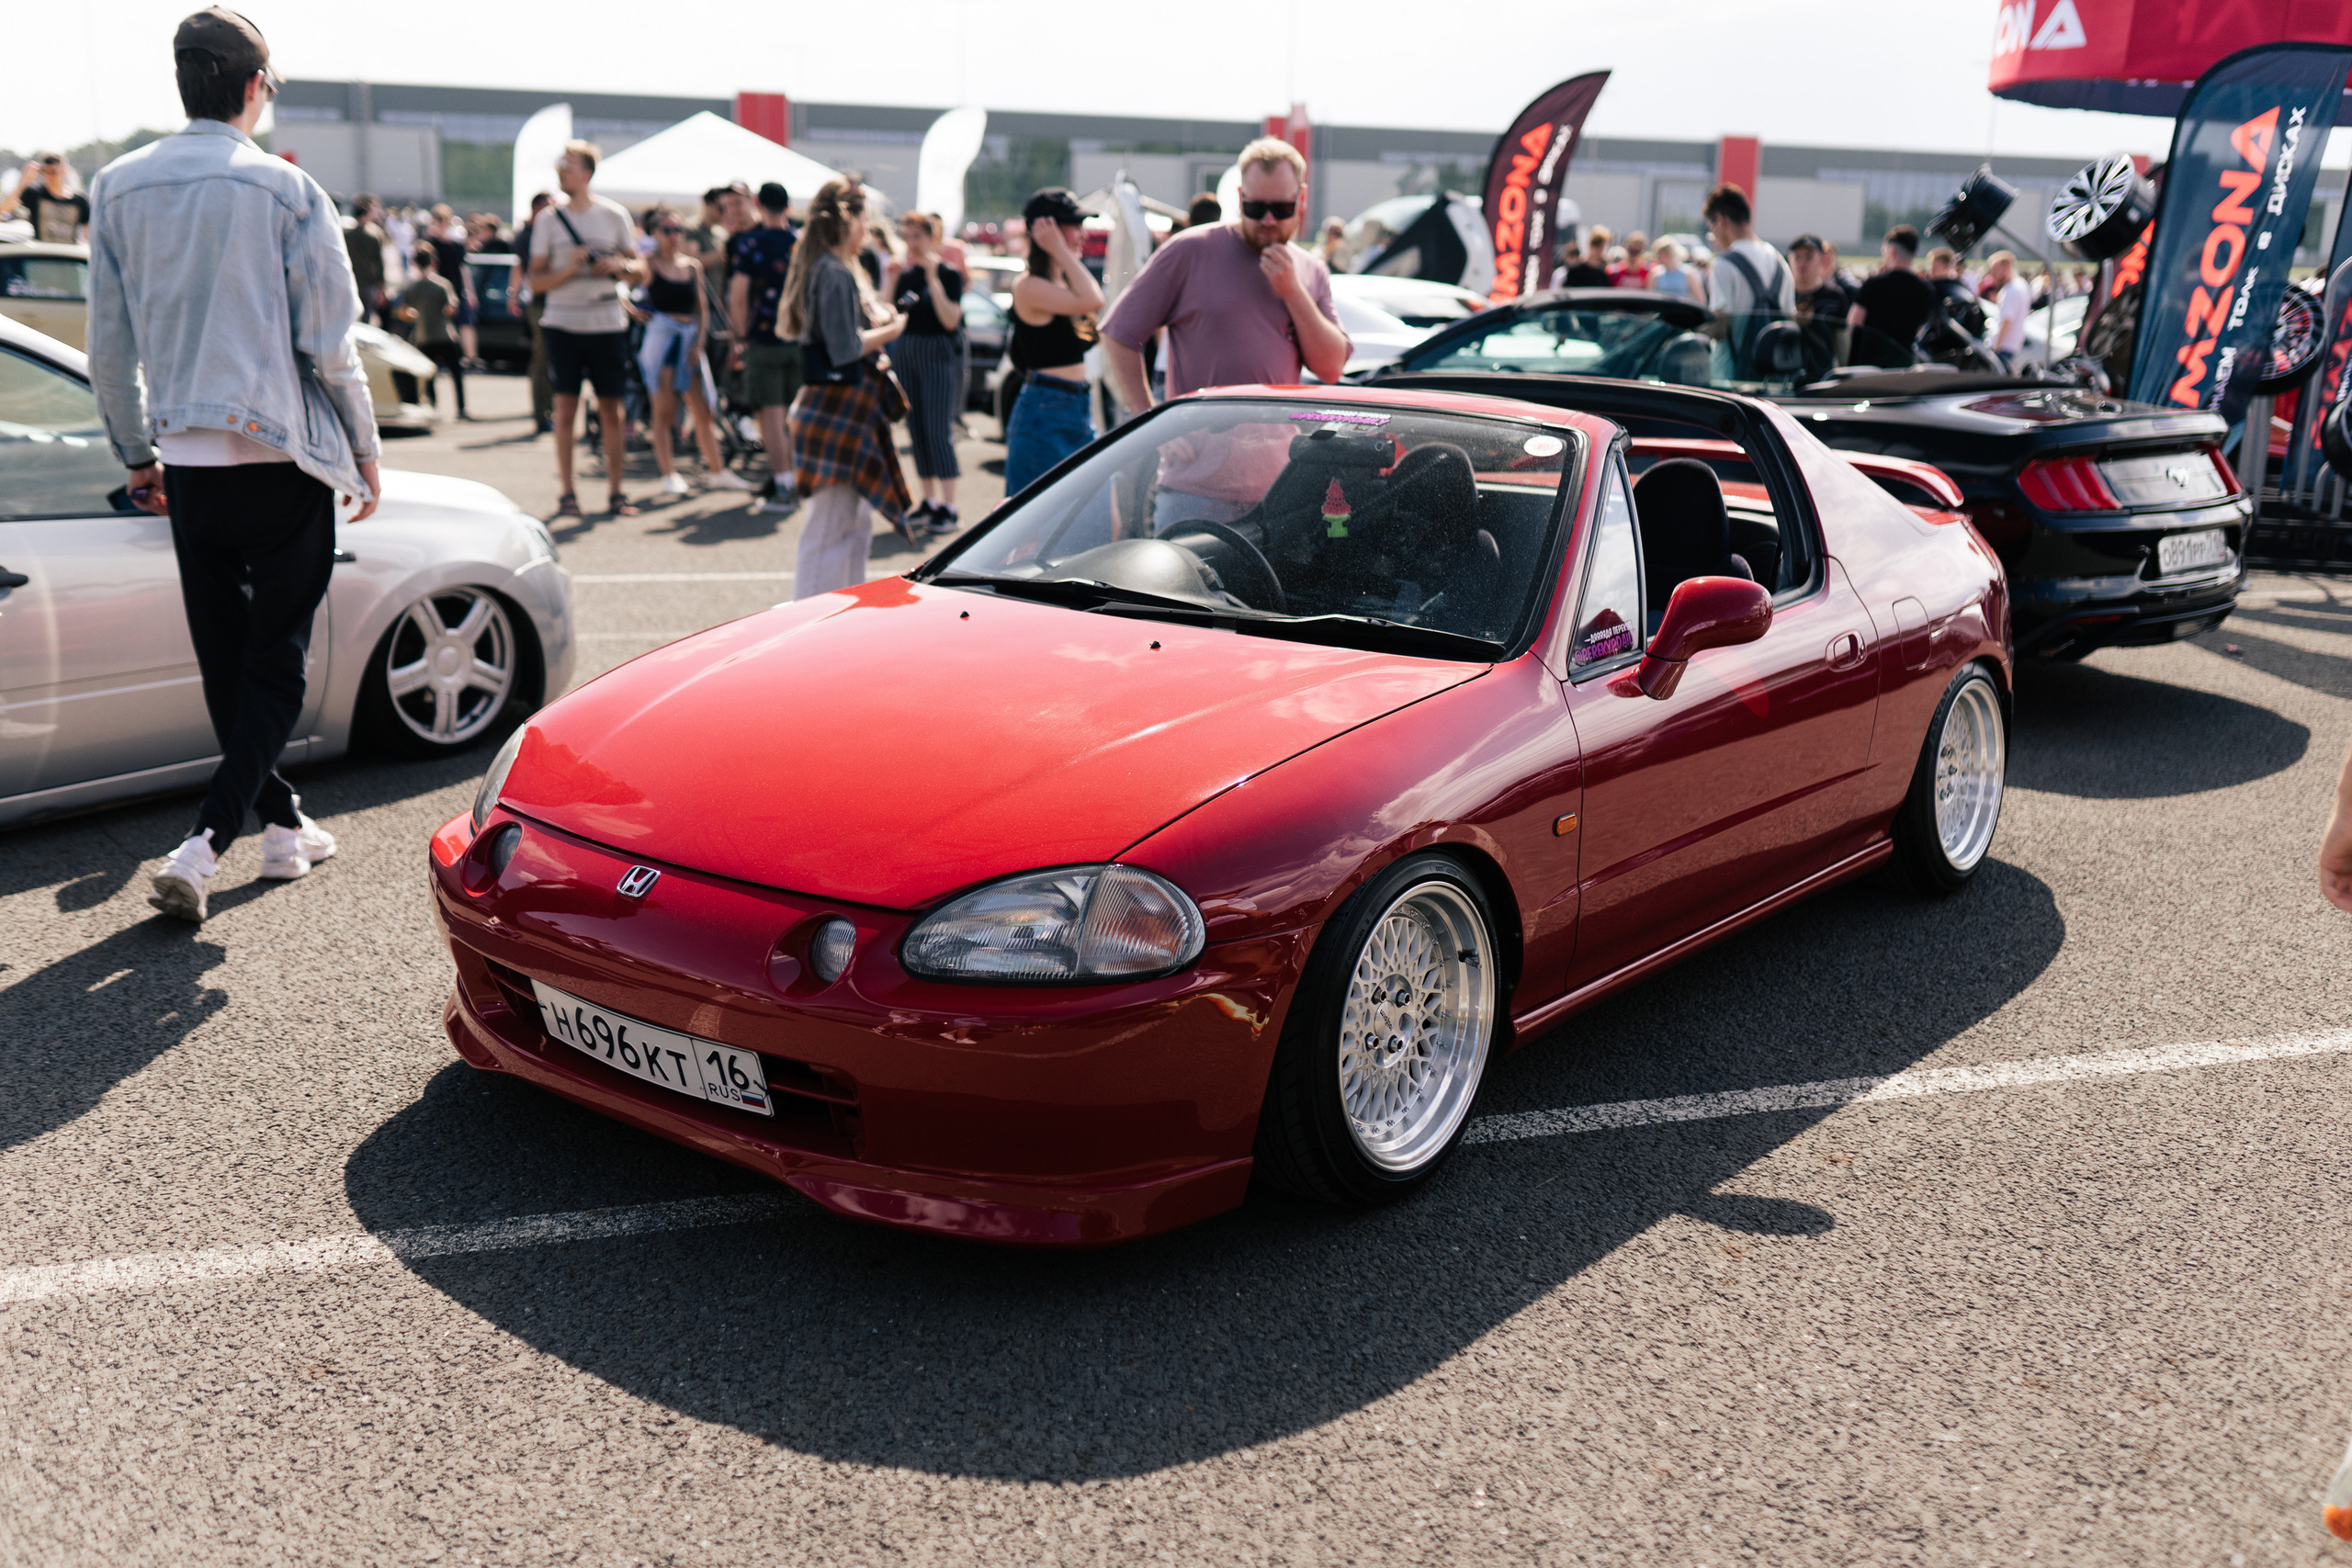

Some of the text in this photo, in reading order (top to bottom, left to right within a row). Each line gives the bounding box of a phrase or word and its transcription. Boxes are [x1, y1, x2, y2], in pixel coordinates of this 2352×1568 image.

[2267, 106, 2307, 217] ДИСКАХ
[705, 1050, 751, 1090] 16
[707, 1082, 741, 1102] RUS
